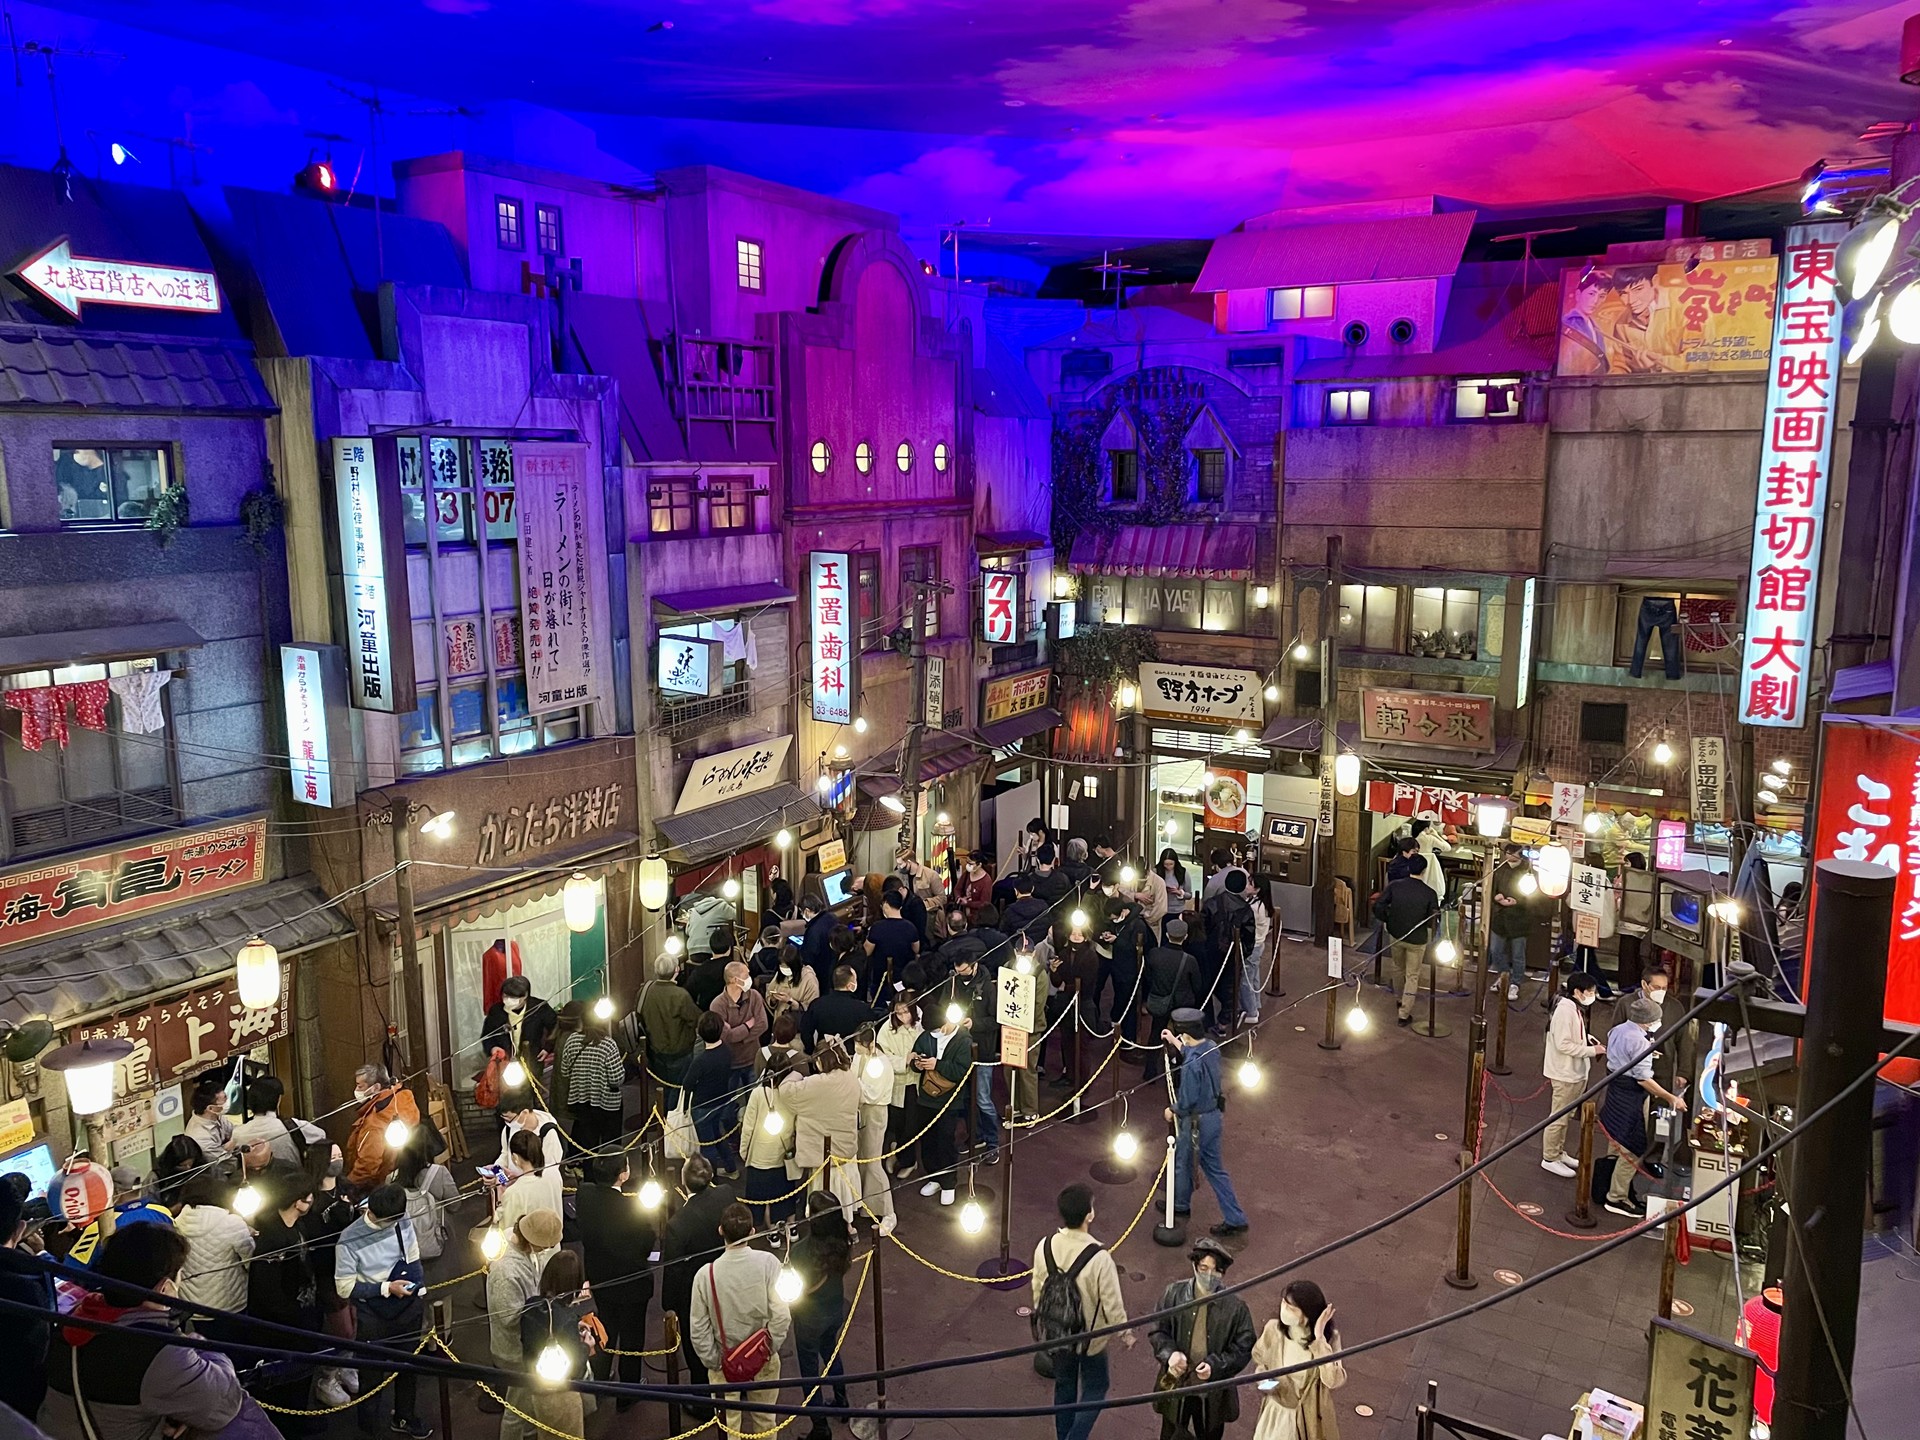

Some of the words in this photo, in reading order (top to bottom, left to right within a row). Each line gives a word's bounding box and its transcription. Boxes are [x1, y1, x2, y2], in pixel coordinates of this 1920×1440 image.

[44, 265, 214, 303] 丸越百貨店への近道
[343, 446, 365, 463] 三階
[988, 576, 1013, 642] クスリ
[818, 562, 846, 698] 玉置歯科
[358, 608, 383, 700] 河童出版
[538, 685, 588, 704] 河童出版
[929, 660, 941, 718] 川添硝子
[1157, 677, 1244, 704] 野方ホープ
[816, 706, 848, 718] 33-6488
[1191, 705, 1211, 714] 1994
[1320, 775, 1332, 824] 佐藤質店
[1696, 765, 1719, 812] 田辺書店
[478, 782, 622, 865] からたち洋装店
[182, 835, 248, 861] 赤湯からみそ
[187, 858, 248, 885] ラーメン
[1578, 871, 1594, 905] 通堂
